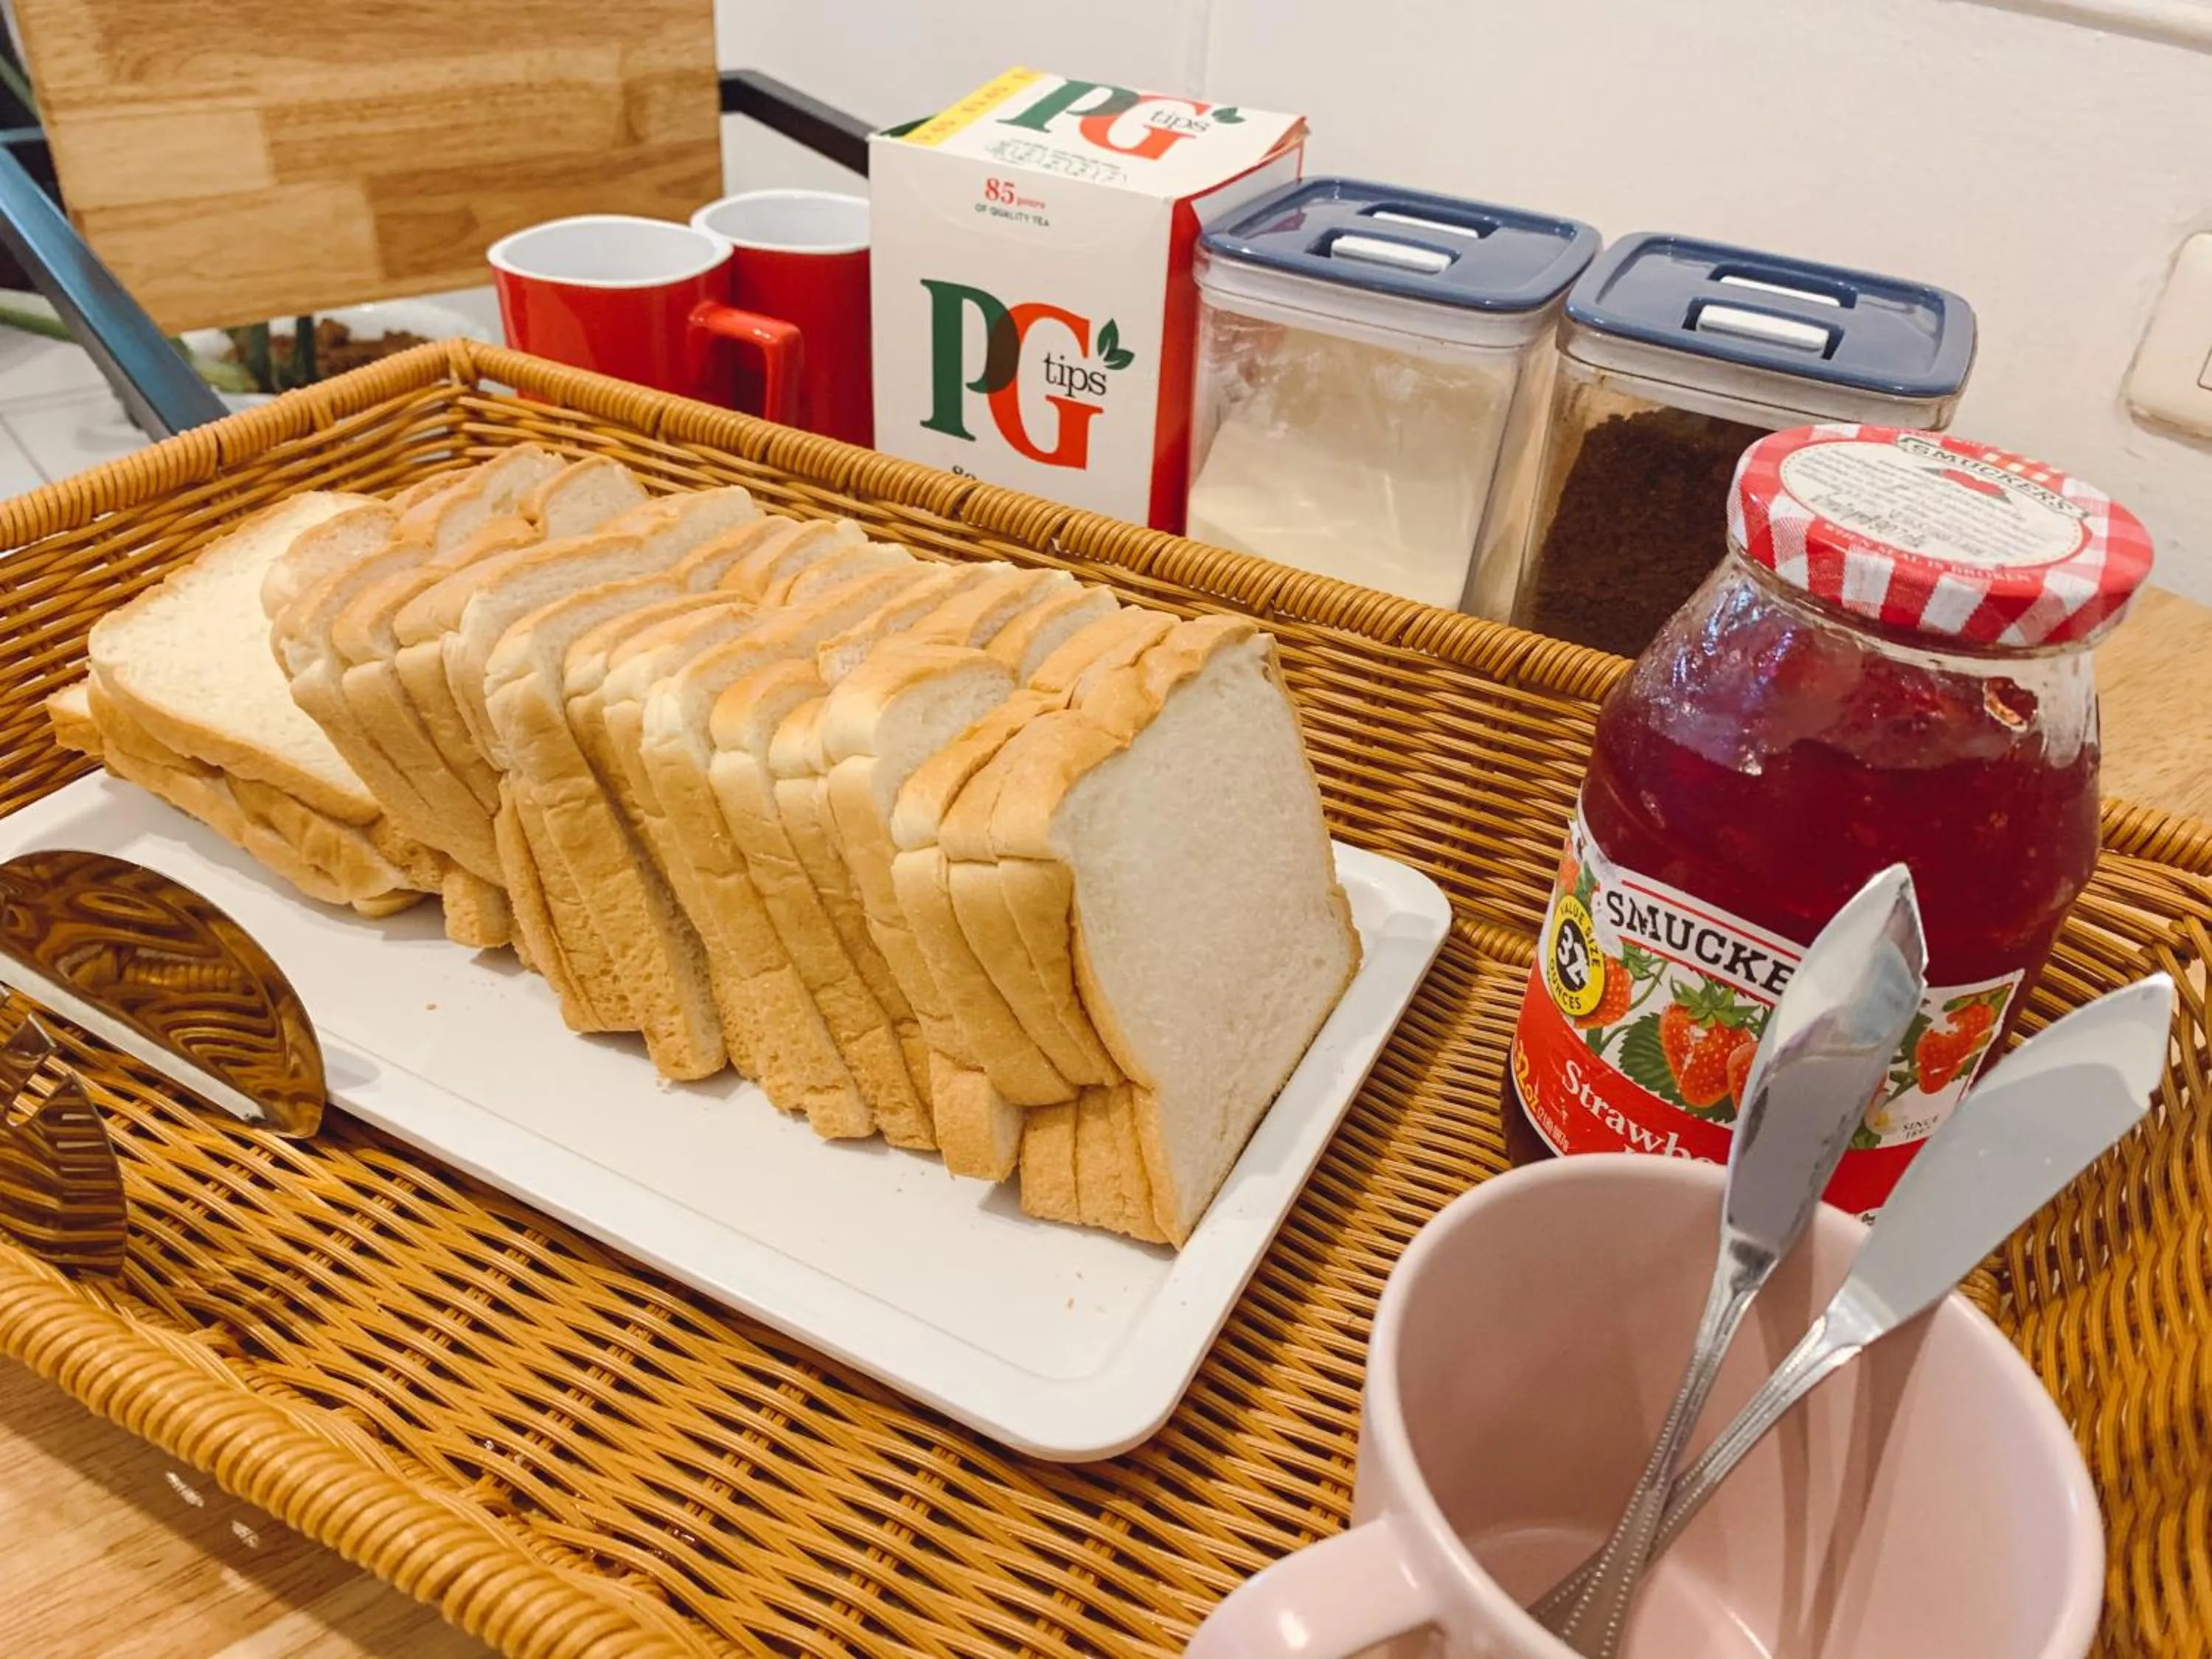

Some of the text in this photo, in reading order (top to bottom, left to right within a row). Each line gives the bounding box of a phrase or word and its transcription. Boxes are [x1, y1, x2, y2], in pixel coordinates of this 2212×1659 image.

[995, 79, 1211, 161] PG
[1150, 110, 1210, 132] tips
[975, 204, 1049, 226] OF QUALITY TEA
[984, 178, 1015, 204] 85
[920, 278, 1107, 470] PG tips
[1606, 890, 1795, 996] SMUCKE
